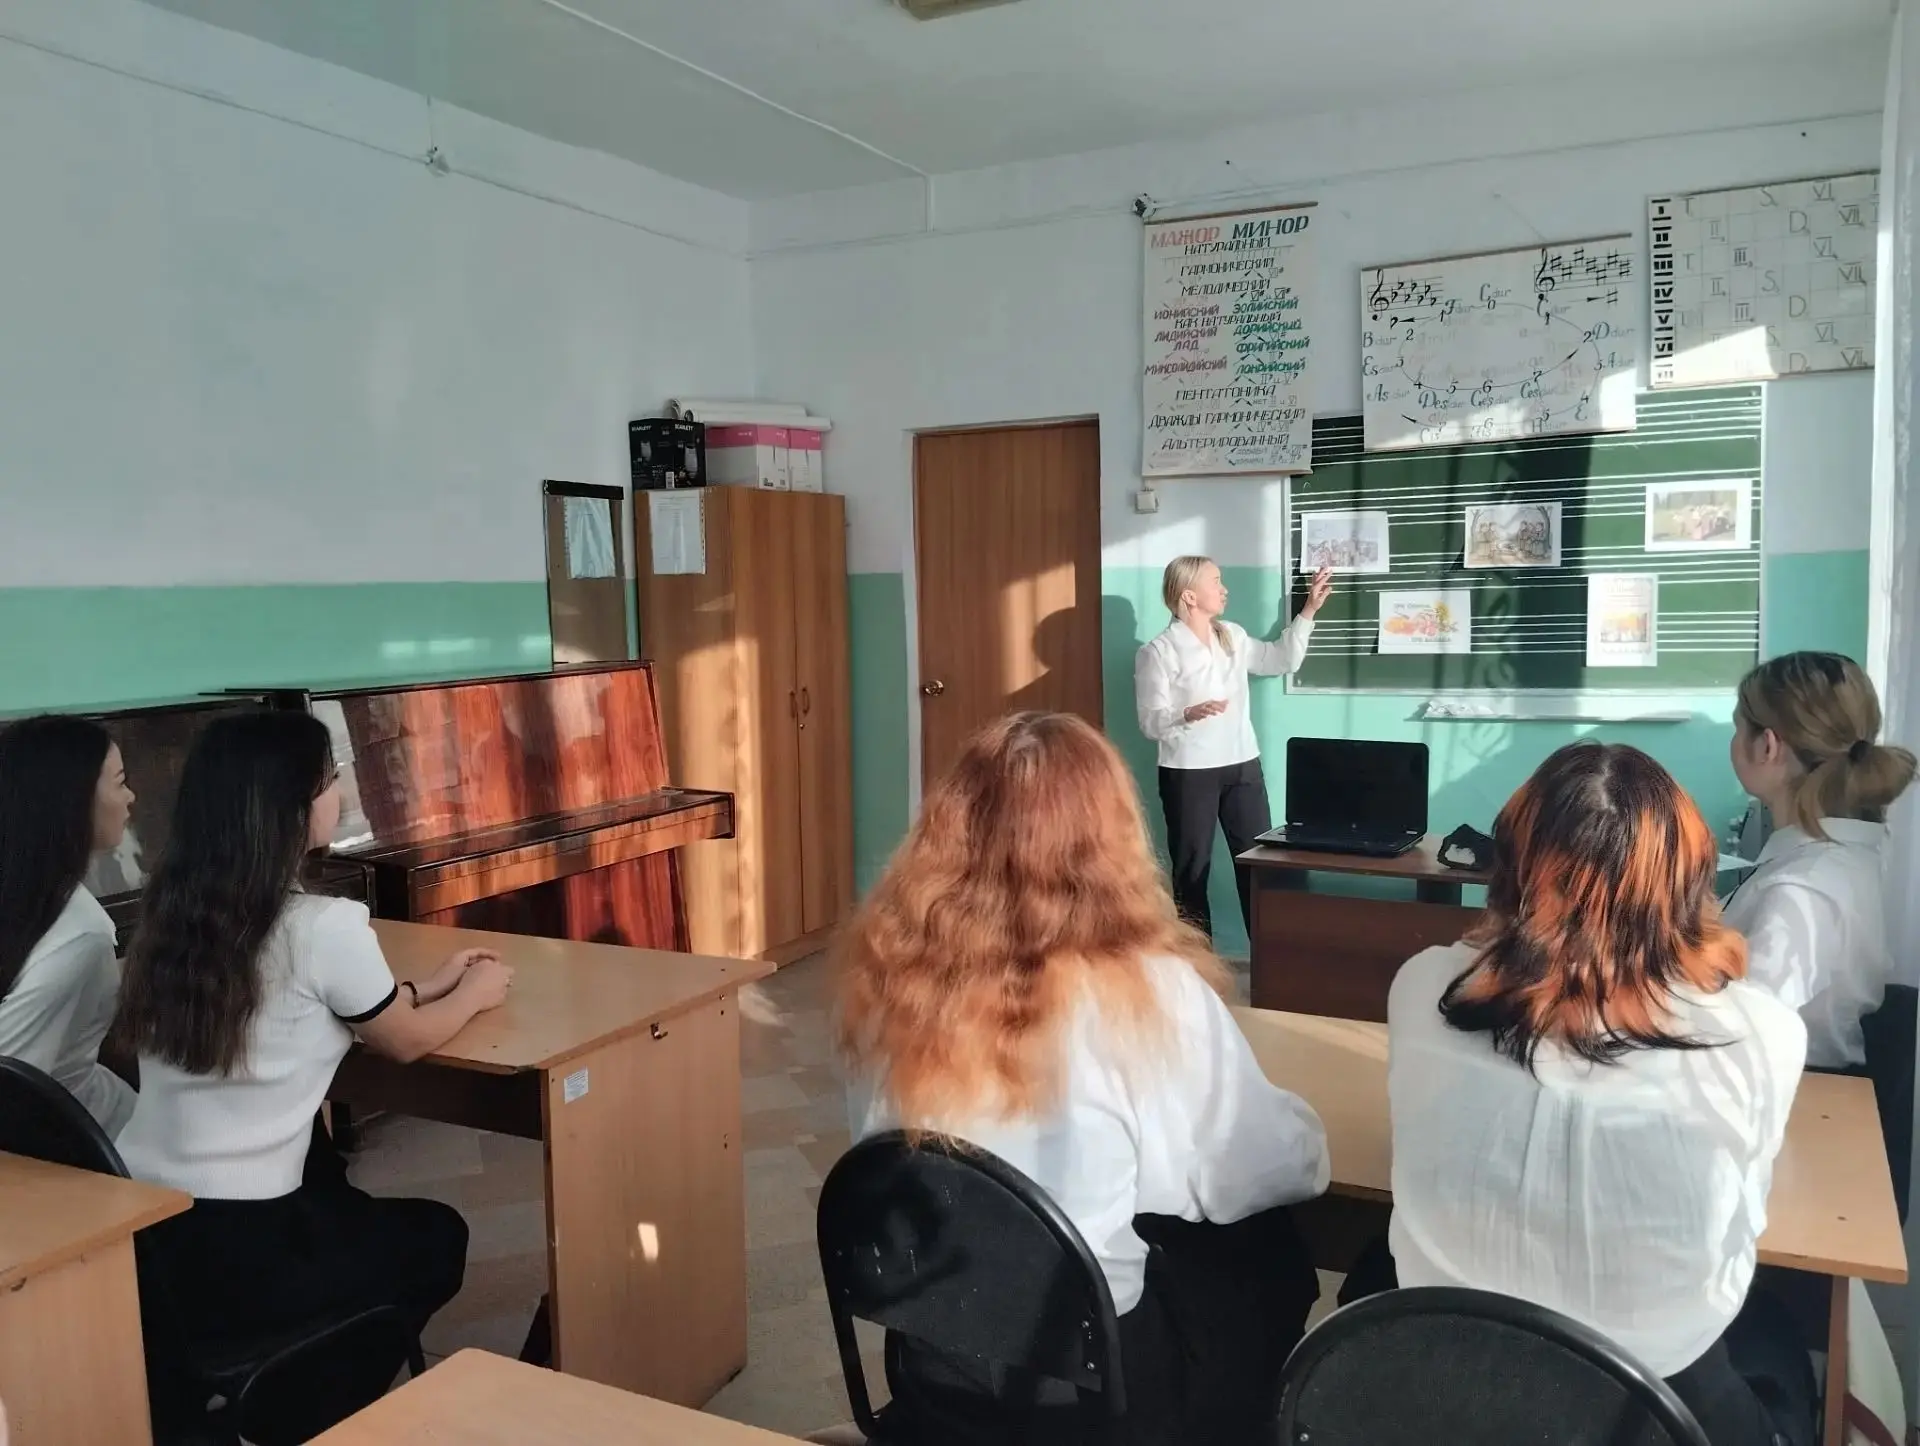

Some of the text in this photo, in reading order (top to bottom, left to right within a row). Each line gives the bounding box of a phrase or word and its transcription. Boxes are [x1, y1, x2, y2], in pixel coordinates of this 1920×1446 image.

[1150, 215, 1309, 249] МАЖОР МИНОР
[1184, 237, 1271, 255] НАТУРАЛЬНЫЙ
[1180, 257, 1275, 276] ГАРМОНИЧЕСКИЙ
[1181, 278, 1271, 297] МЕЛОДИЧЕСКИЙ
[1154, 304, 1220, 320] ИОНИЙСКИЙ
[1232, 299, 1299, 315] ЭОЛИЙСКИЙ
[1175, 311, 1281, 329] КАК НАТУРАЛЬНЫЙ
[1233, 319, 1302, 336] ДОРИЙСКИЙ
[1154, 327, 1218, 343] ЛИДИЙСКИЙ
[1611, 328, 1635, 337] dur
[1173, 340, 1200, 351] ЛАД
[1236, 336, 1310, 353] ФРИГИЙСКИЙ
[1145, 355, 1228, 376] МИКСОЛИДИЙСКИЙ
[1175, 385, 1276, 401] ПЕНТАТОНИКА
[674, 423, 694, 431] SCARLETT
[1148, 408, 1306, 430] ДВАЖДЫ ГАРМОНИЧЕСКИЙ
[1161, 433, 1290, 450] АЛЬТЕРИРОВАННЫЙ
